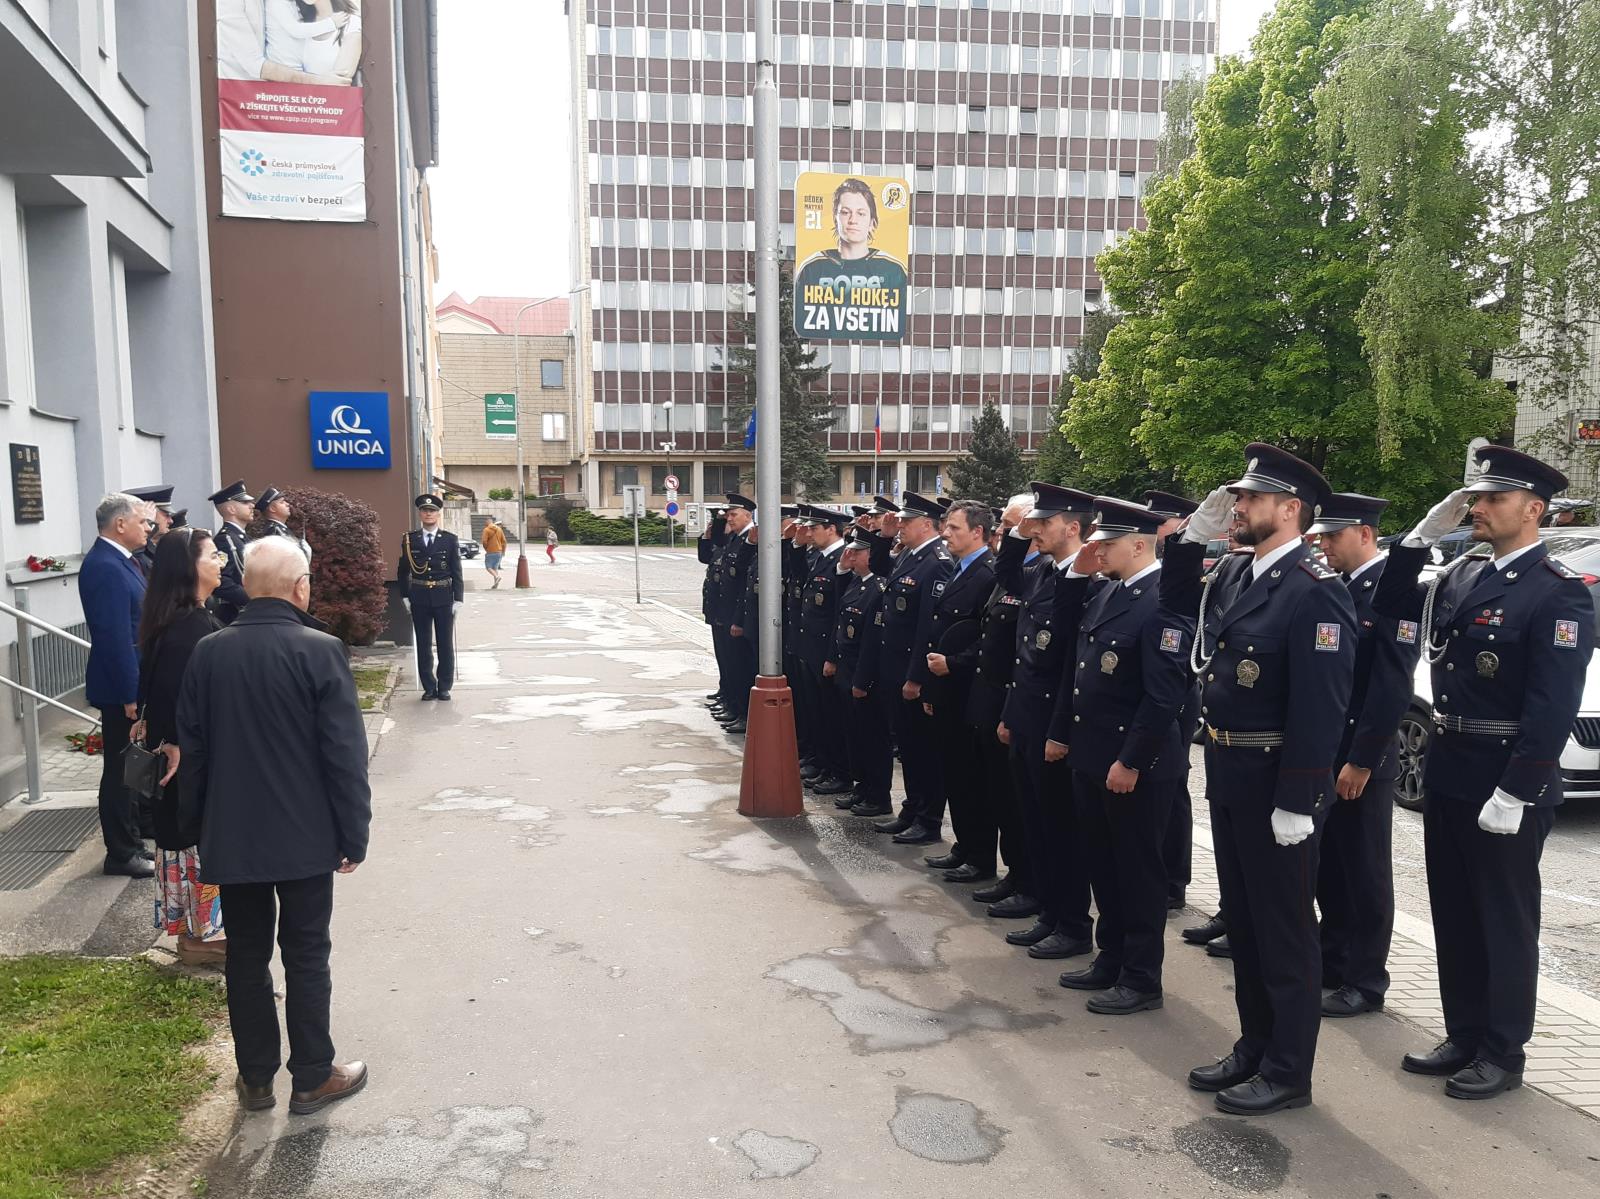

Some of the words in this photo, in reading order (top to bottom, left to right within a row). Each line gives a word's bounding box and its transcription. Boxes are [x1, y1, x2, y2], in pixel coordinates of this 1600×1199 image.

[256, 93, 290, 103] PŘIPOJTE
[291, 95, 301, 103] SE
[302, 96, 307, 104] K
[308, 95, 327, 104] ČPZP
[246, 101, 279, 112] ZÍSKEJTE
[279, 104, 313, 114] VŠECHNY
[314, 105, 344, 116] VÝHODY
[269, 115, 338, 125] www.cpzp.cz/programy
[271, 159, 293, 168] Česká
[295, 160, 336, 171] průmyslová
[271, 170, 305, 179] zdravotní
[307, 171, 344, 181] pojišťovna
[246, 192, 268, 200] Vaše
[270, 193, 298, 203] zdraví
[307, 195, 343, 205] bezpečí
[805, 210, 822, 230] 21
[804, 285, 844, 304] HRAJ
[851, 288, 899, 306] HOKEJ
[803, 305, 830, 331] ZA
[833, 304, 899, 333] VSETÍN
[317, 439, 385, 456] UNIQA
